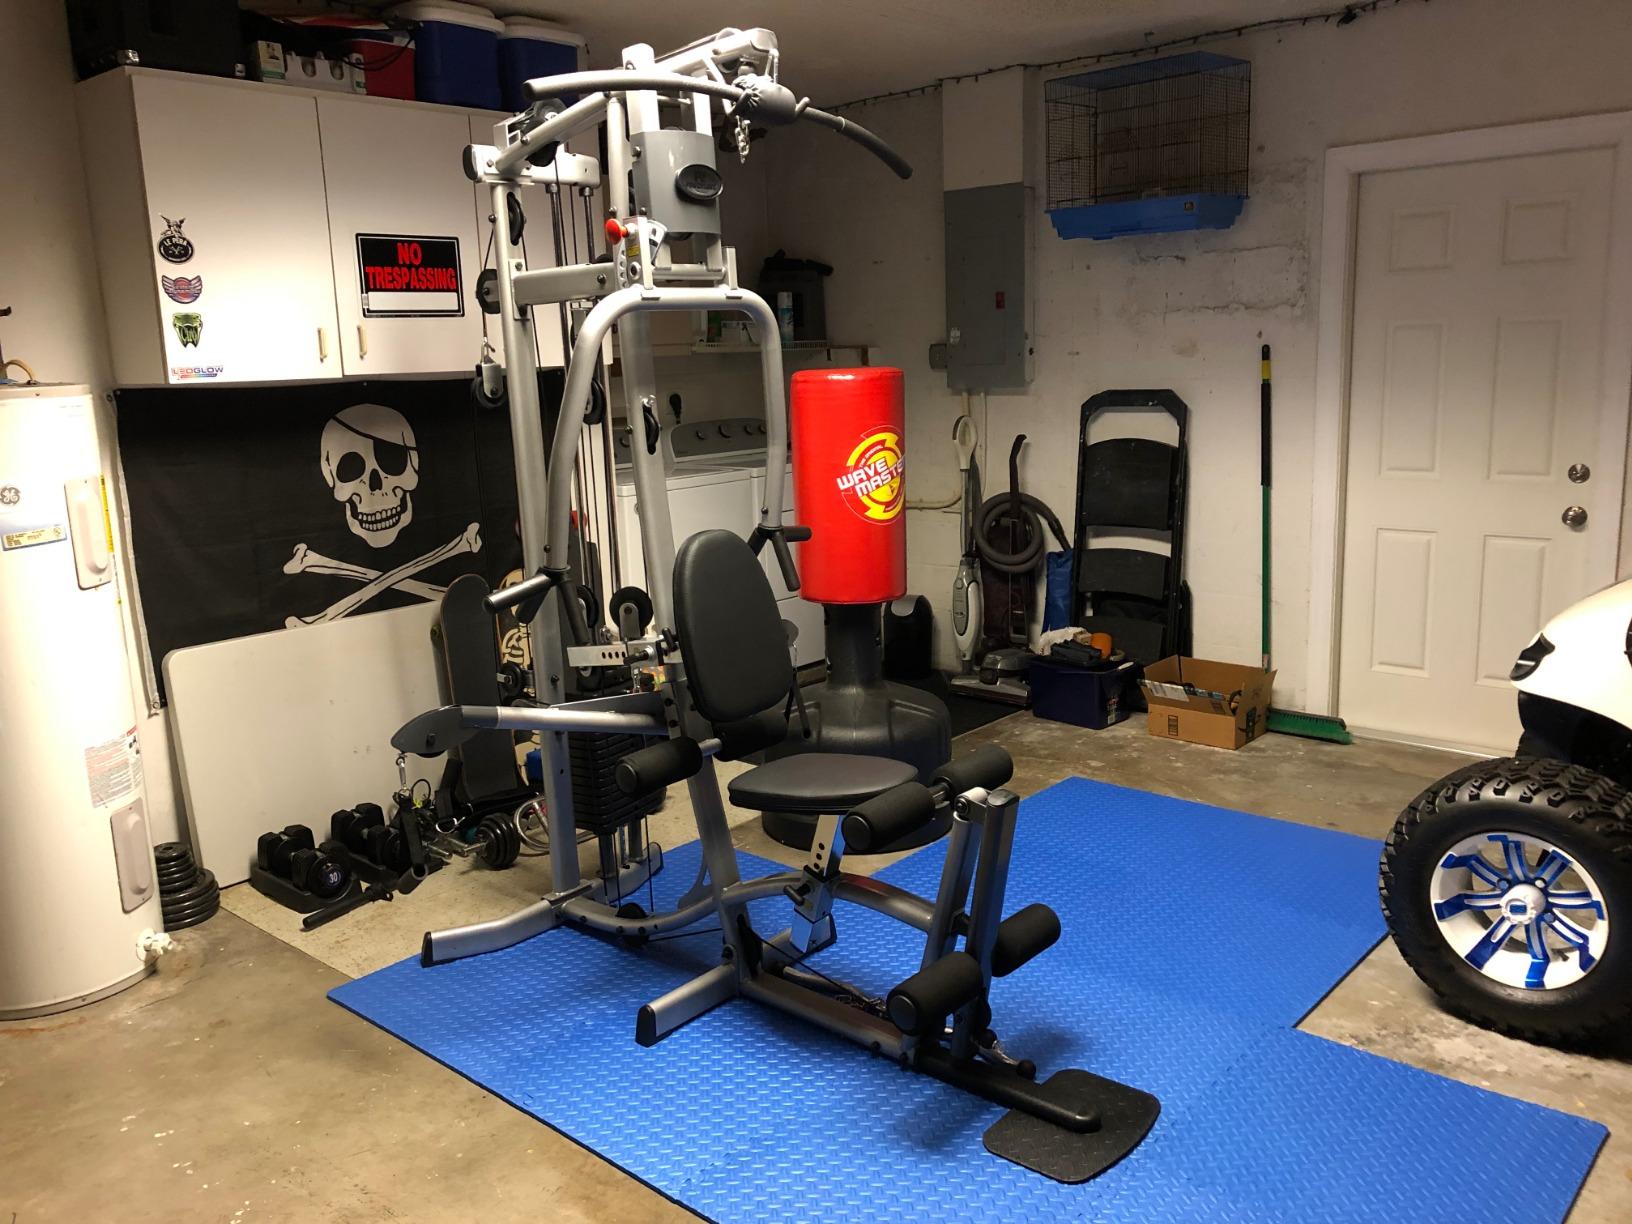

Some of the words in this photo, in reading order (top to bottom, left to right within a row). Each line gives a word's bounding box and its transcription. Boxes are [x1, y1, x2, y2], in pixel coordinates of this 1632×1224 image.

[397, 242, 422, 265] NO
[365, 266, 456, 290] TRESPASSING
[173, 367, 224, 375] LEDGLOW
[836, 457, 887, 490] WAVE
[855, 460, 904, 497] MASTE
[329, 872, 338, 883] 30
